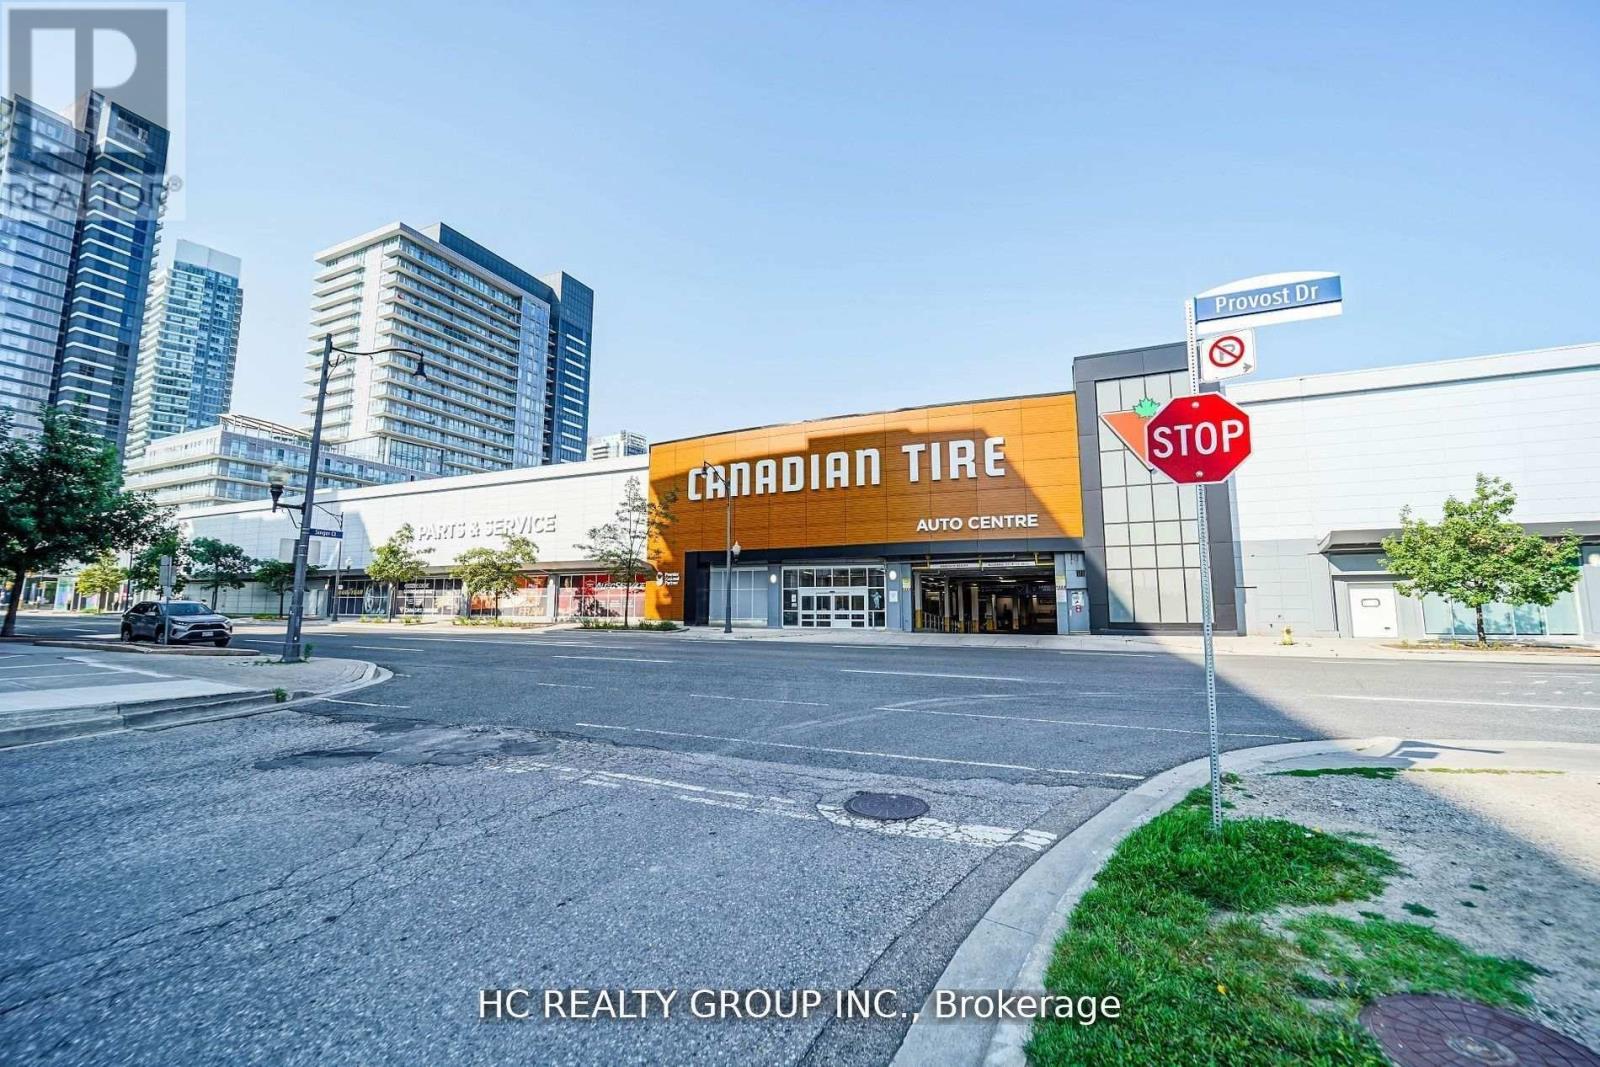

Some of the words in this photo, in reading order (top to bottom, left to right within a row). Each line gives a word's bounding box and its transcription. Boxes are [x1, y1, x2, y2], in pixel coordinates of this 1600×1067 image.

[1215, 287, 1290, 313] Provost
[1296, 283, 1319, 303] Dr
[1153, 419, 1244, 459] STOP
[688, 447, 880, 501] CANADIAN
[902, 437, 1006, 483] TIRE
[418, 521, 466, 541] PARTS
[470, 521, 481, 538] &
[484, 514, 557, 538] SERVICE
[916, 516, 963, 532] AUTO
[968, 513, 1040, 530] CENTRE
